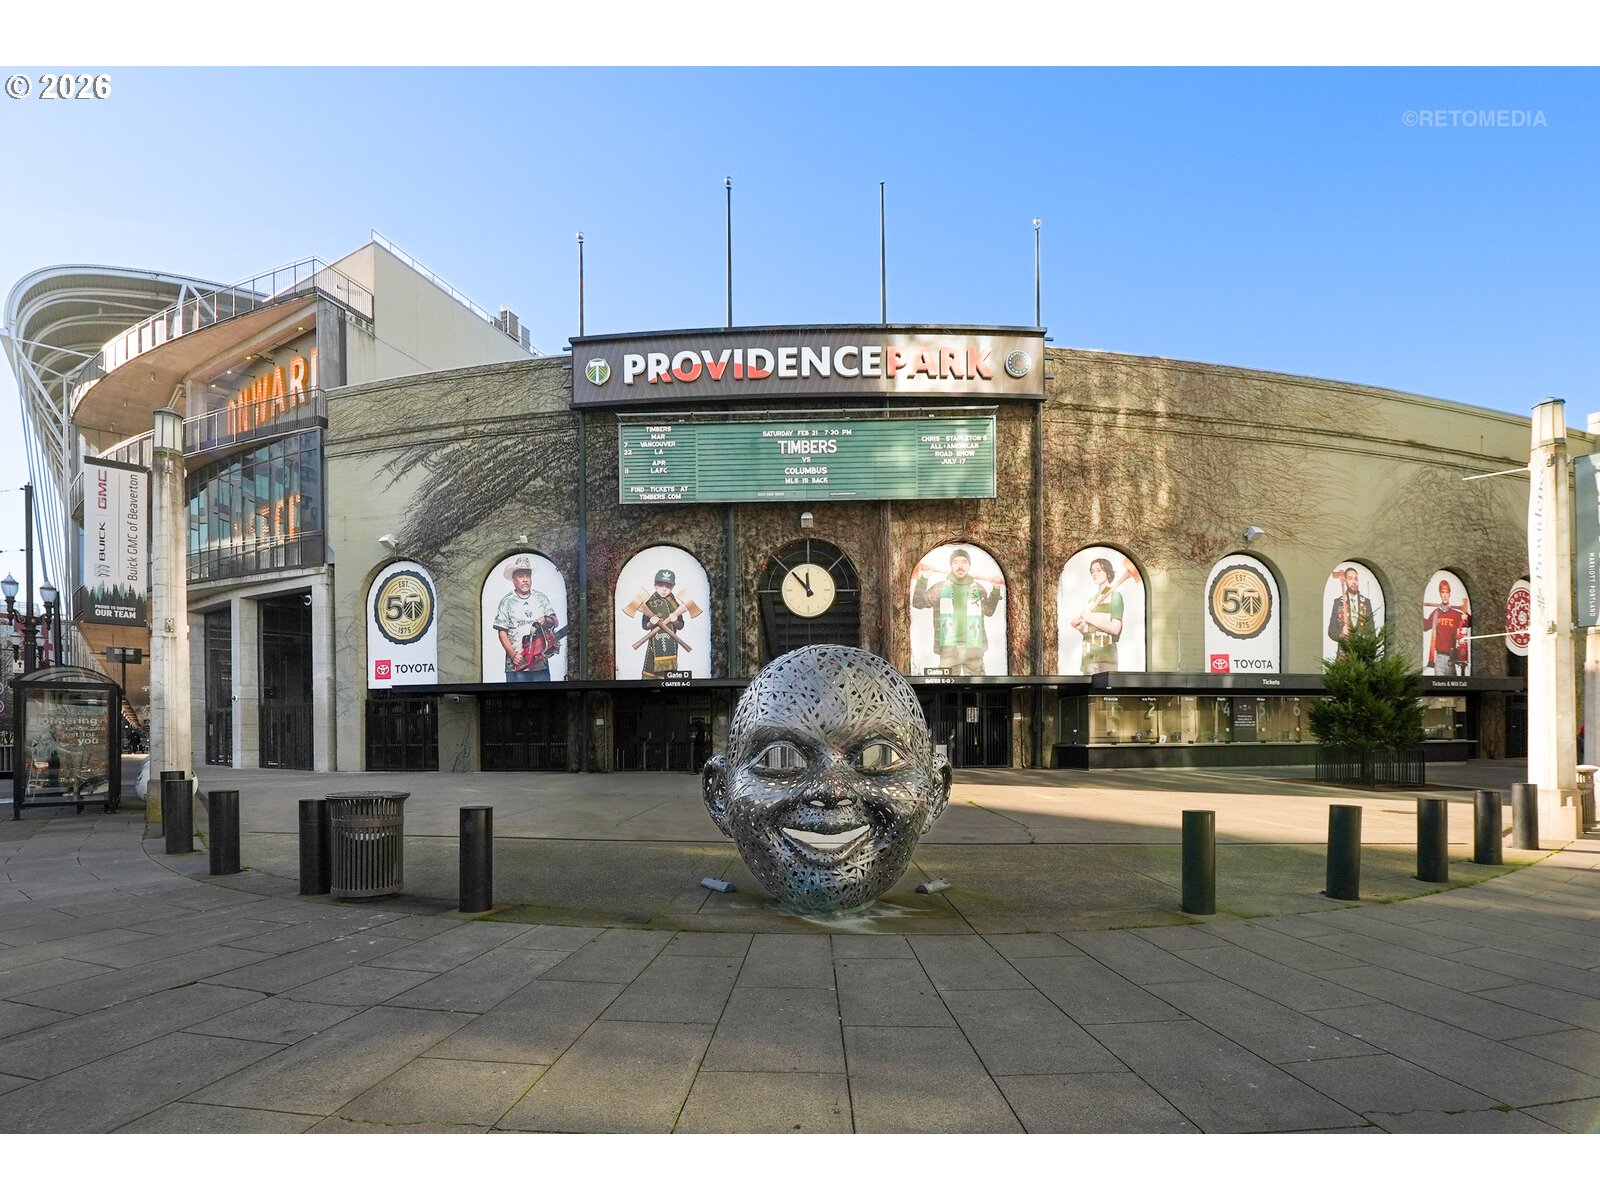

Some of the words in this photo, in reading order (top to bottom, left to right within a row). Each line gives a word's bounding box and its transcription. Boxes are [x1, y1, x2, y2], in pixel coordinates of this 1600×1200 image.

[623, 345, 882, 385] PROVIDENCE
[885, 345, 993, 380] PARK
[777, 440, 838, 454] TIMBERS
[784, 467, 828, 475] COLUMBUS
[98, 470, 107, 510] GMC
[127, 474, 138, 520] Beaverton
[129, 521, 138, 532] of
[127, 534, 138, 556] GMC
[127, 556, 138, 582] Buick
[1588, 552, 1596, 582] MARRIOTT
[1588, 585, 1596, 617] PORTLAND
[95, 609, 112, 617] OUR
[114, 610, 136, 619] TEAM
[397, 626, 411, 634] 1975
[1236, 621, 1250, 629] 1975
[395, 663, 435, 673] TOYOTA
[1234, 659, 1273, 669] TOYOTA
[1223, 703, 1231, 716] 4
[1293, 703, 1300, 716] 6
[77, 738, 99, 746] you
